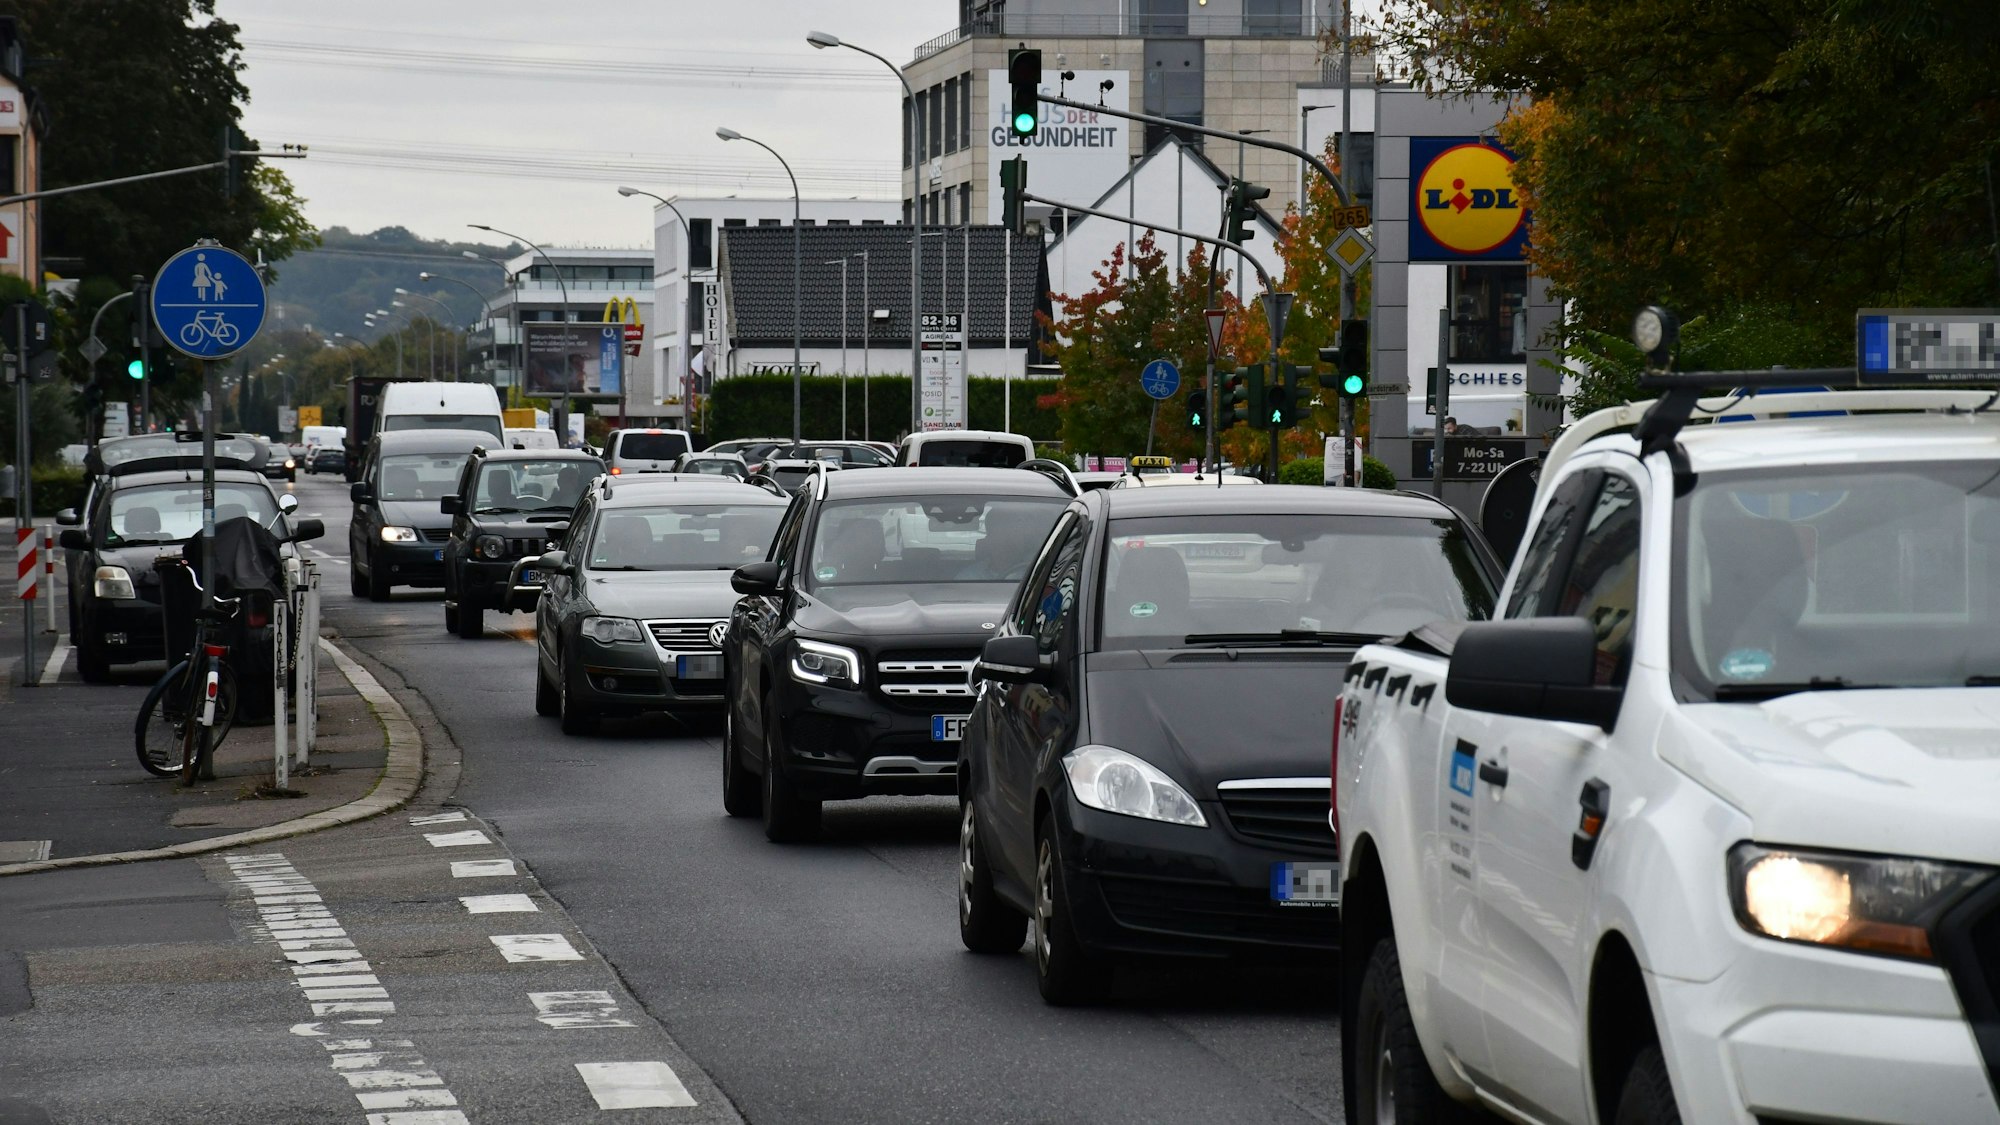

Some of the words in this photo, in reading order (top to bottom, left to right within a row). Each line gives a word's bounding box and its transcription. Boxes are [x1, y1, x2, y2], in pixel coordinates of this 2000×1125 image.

[1001, 103, 1066, 124] HUS
[1067, 110, 1098, 124] DER
[1337, 209, 1365, 226] 265
[706, 284, 718, 341] HOTEL
[1463, 447, 1505, 458] Mo-Sa
[1138, 457, 1164, 466] TAXI
[1458, 463, 1485, 473] 7-22
